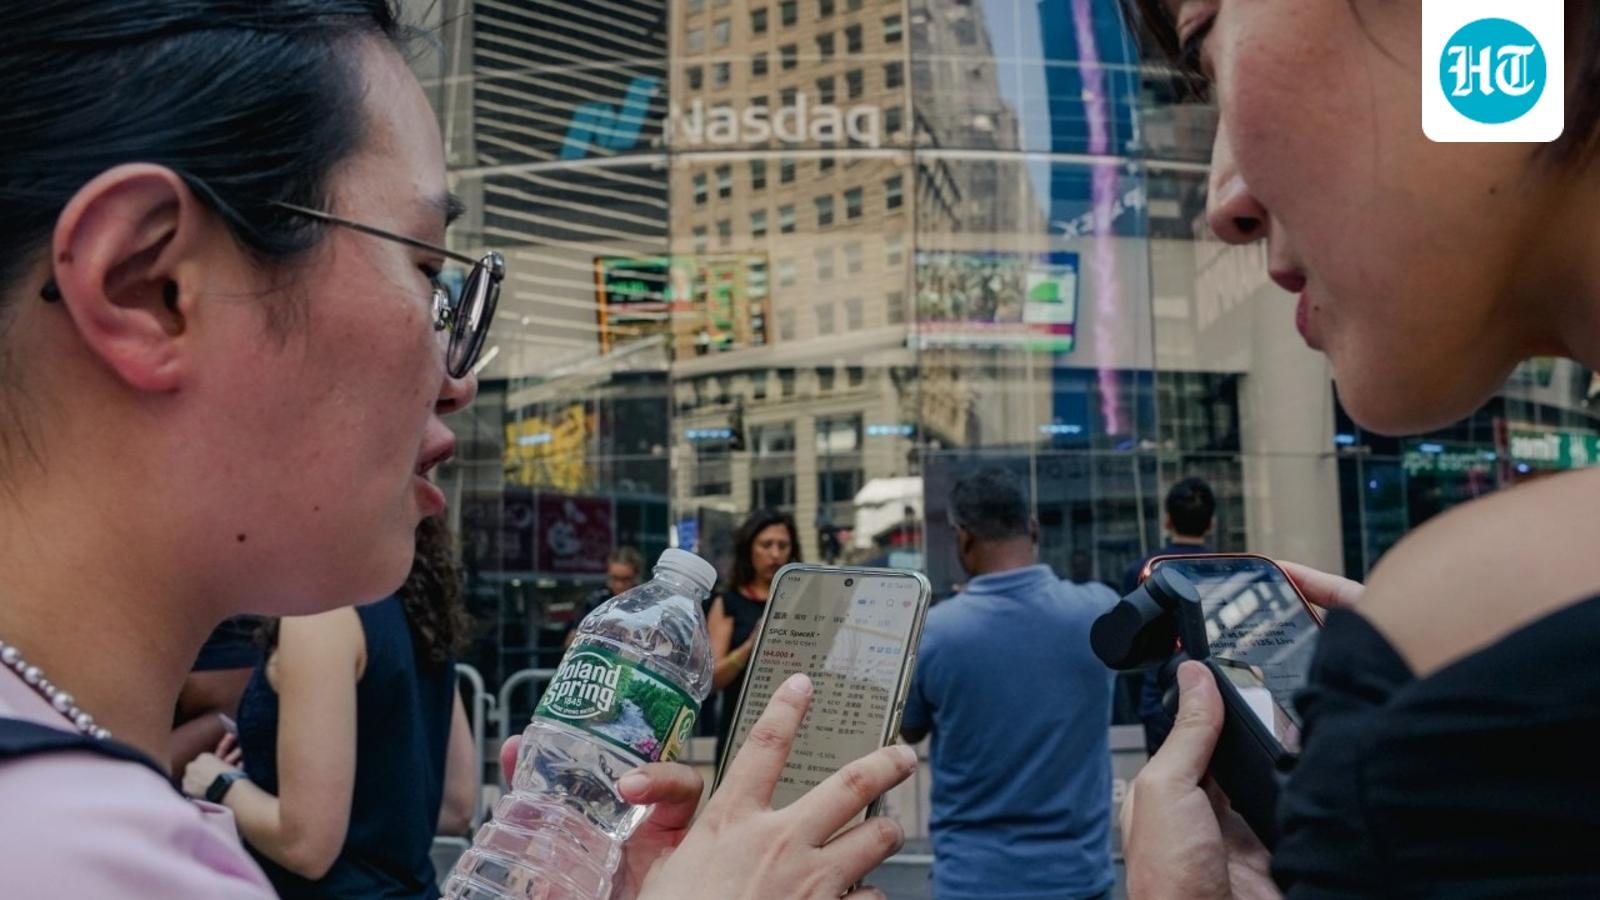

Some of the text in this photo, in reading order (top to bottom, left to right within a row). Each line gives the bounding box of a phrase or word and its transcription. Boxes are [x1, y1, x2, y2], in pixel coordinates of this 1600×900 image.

[663, 92, 881, 148] Nasdaq
[790, 629, 816, 638] SpaceX
[551, 659, 622, 690] Poland
[543, 678, 616, 712] Spring
[564, 697, 582, 706] 1845
